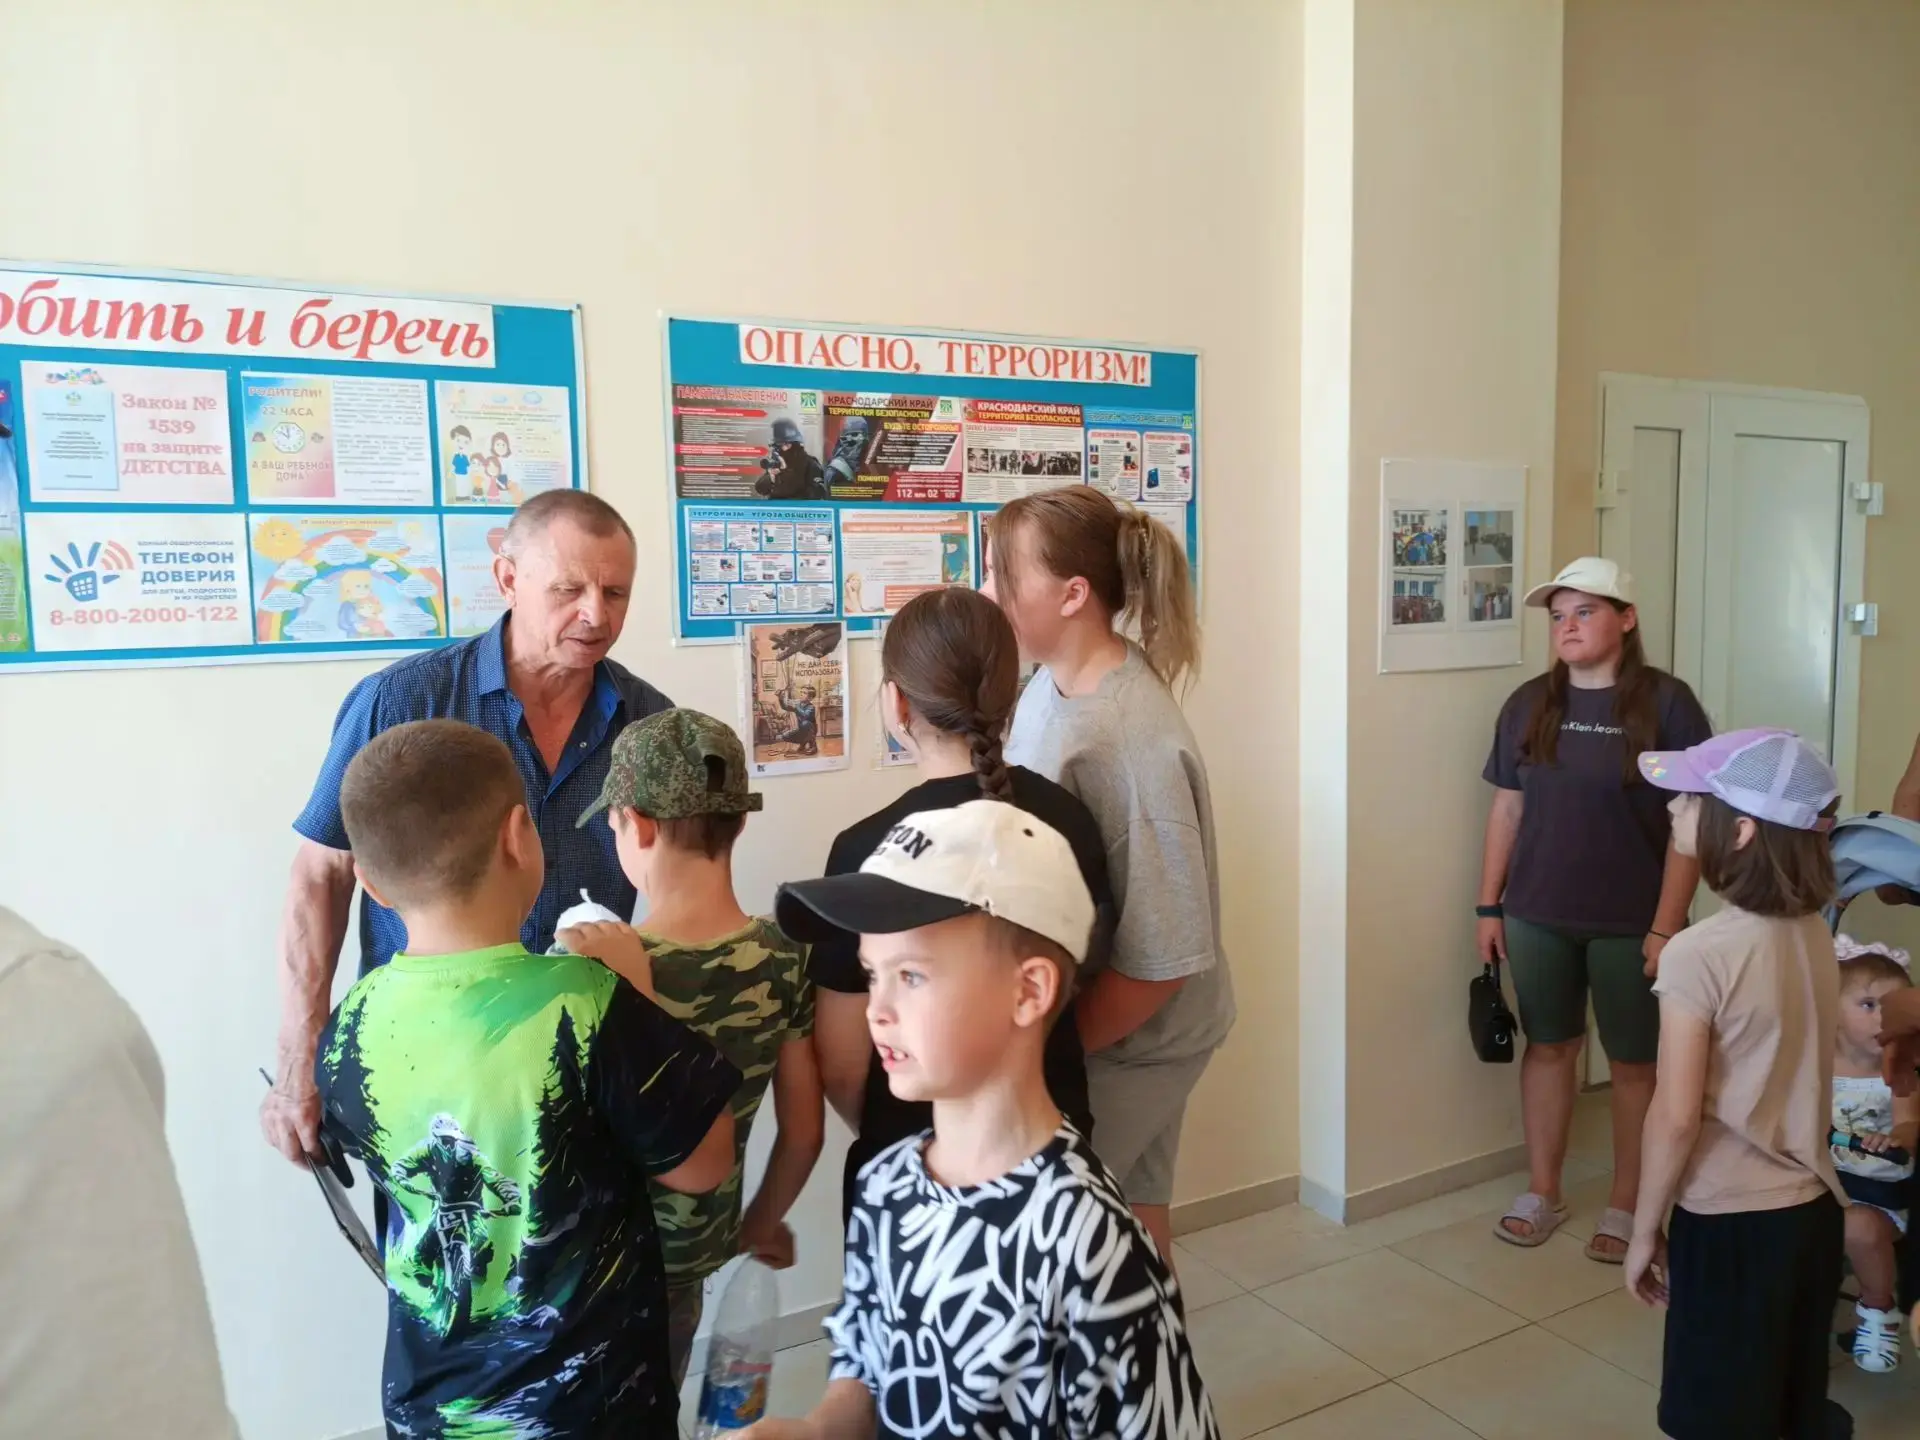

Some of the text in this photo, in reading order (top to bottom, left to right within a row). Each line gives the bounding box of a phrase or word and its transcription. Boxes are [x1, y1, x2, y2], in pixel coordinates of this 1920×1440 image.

[226, 307, 266, 347] и
[289, 297, 490, 360] беречь
[744, 327, 1149, 385] ОПАСНО, ТЕРРОРИЗМ!
[249, 386, 322, 398] РОДИТЕЛИ!
[121, 393, 218, 411] Закон №
[828, 396, 933, 409] КРАСНОДАРСКИЙ КРАЙ
[978, 402, 1080, 415] КРАСНОДАРСКИЙ КРАЙ
[280, 408, 314, 416] ЧАСА
[829, 407, 930, 419] ТЕРРИТОРИЯ БЕЗОПАСНОСТИ
[979, 411, 1024, 421] ТЕРРИТОРИЯ
[1026, 413, 1081, 423] БЕЗОПАСНОСТИ
[148, 419, 196, 434] 1539
[122, 442, 146, 454] на
[152, 442, 223, 456] защите
[121, 459, 226, 476] ДЕТСТВА
[896, 489, 913, 499] 112
[927, 489, 939, 499] 02
[138, 552, 234, 565] ТЕЛЕФОН
[141, 570, 236, 586] ДОВЕРИЯ
[50, 605, 238, 626] 8-800-2000-122
